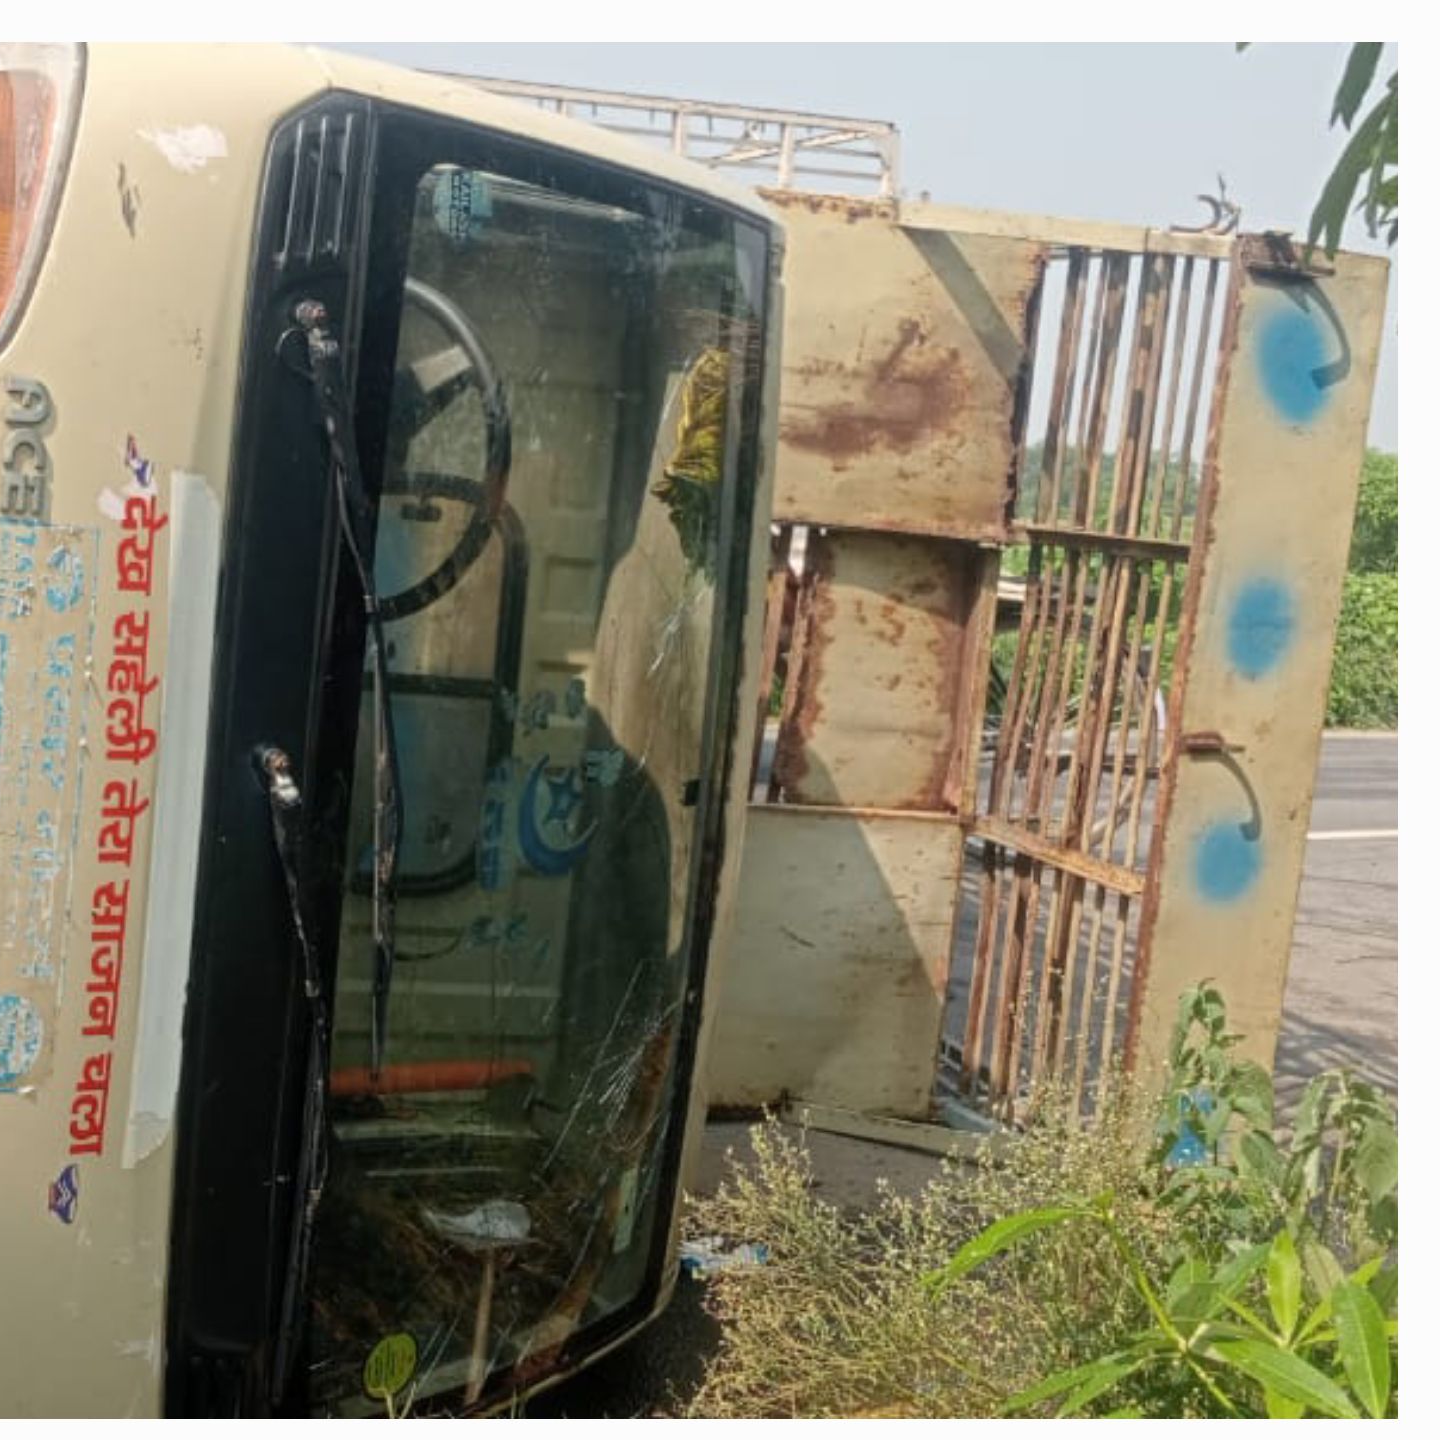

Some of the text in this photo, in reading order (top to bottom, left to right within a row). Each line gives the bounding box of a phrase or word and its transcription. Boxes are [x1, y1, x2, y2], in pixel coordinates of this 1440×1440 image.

[0, 377, 54, 516] ACE
[69, 495, 169, 1156] देख सहेली तेरा साजन चला
